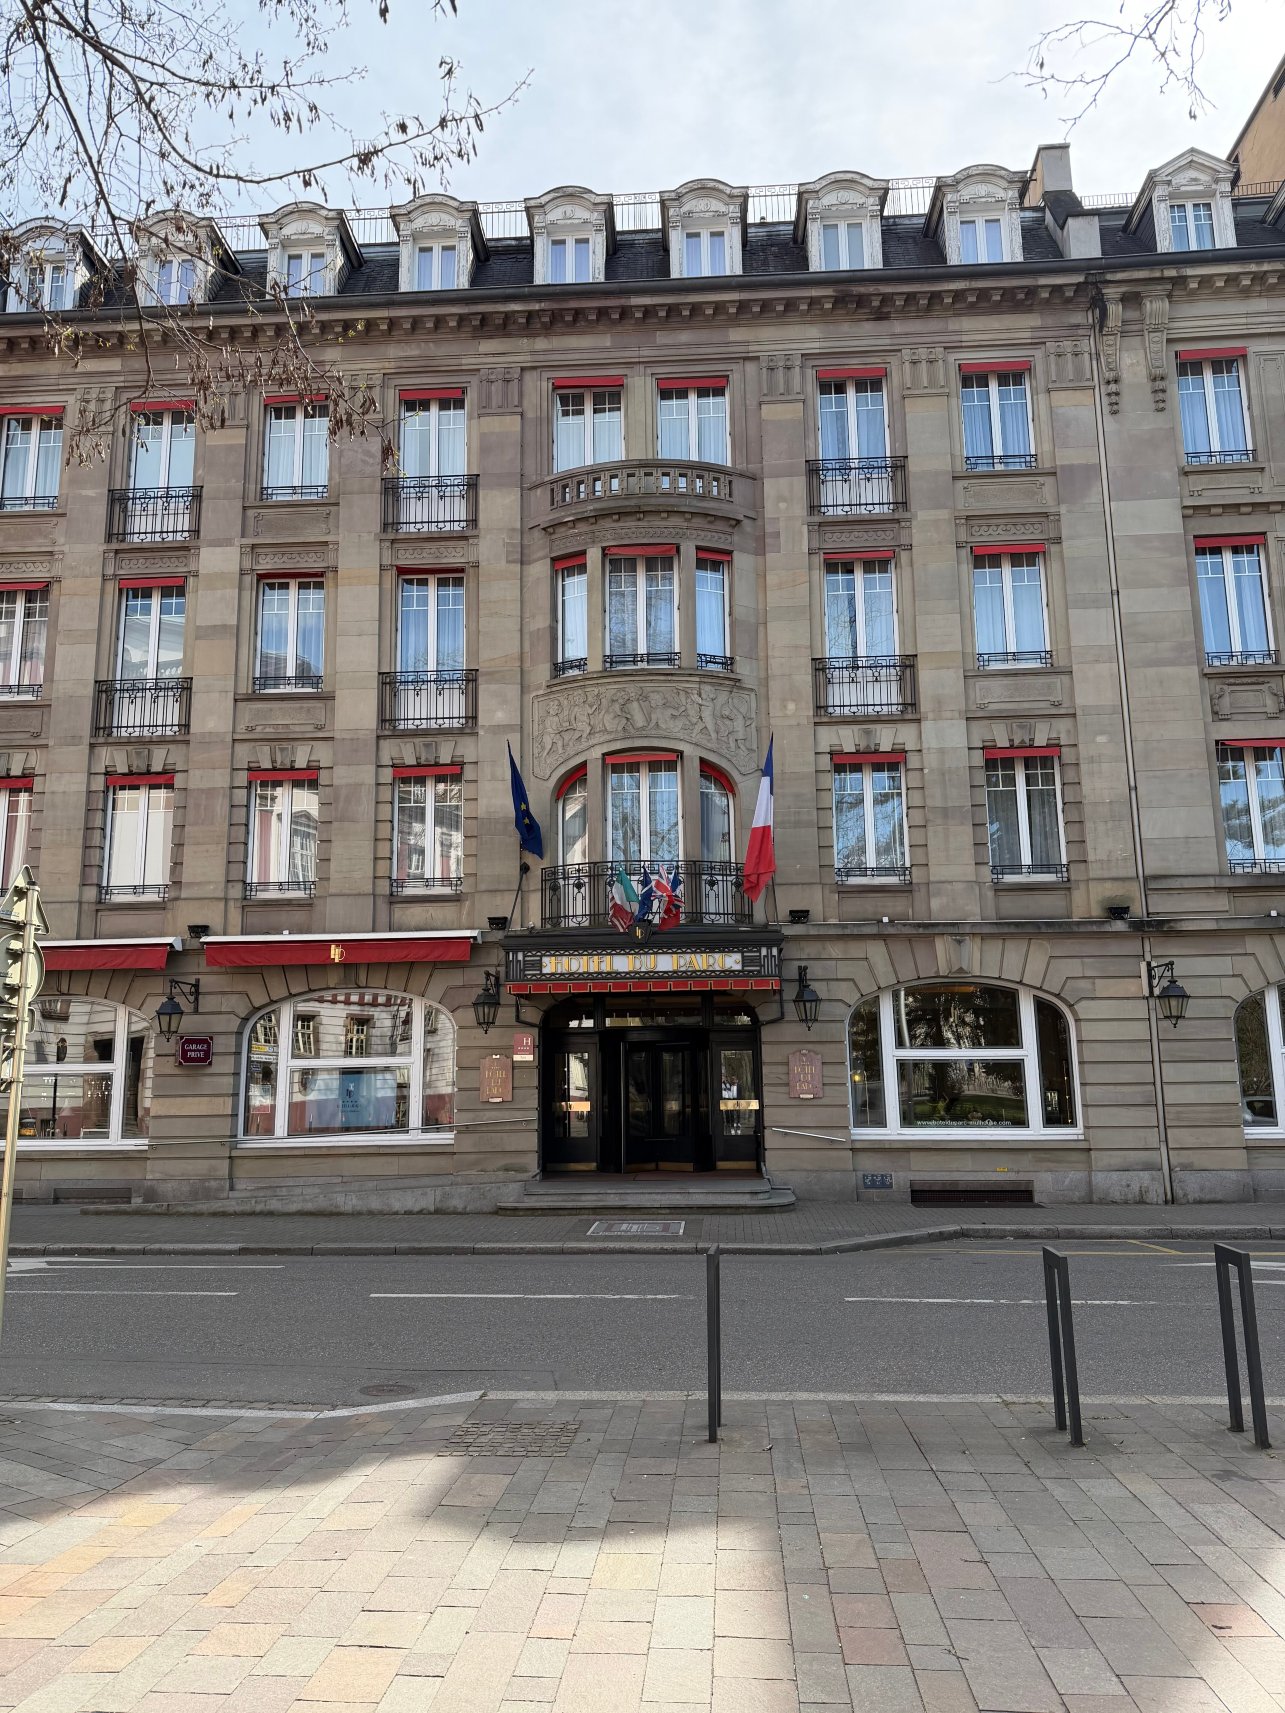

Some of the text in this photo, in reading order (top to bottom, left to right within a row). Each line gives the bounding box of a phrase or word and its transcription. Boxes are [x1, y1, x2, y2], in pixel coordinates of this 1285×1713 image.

[549, 953, 733, 973] HOTEL DU PARC
[523, 1037, 531, 1046] H
